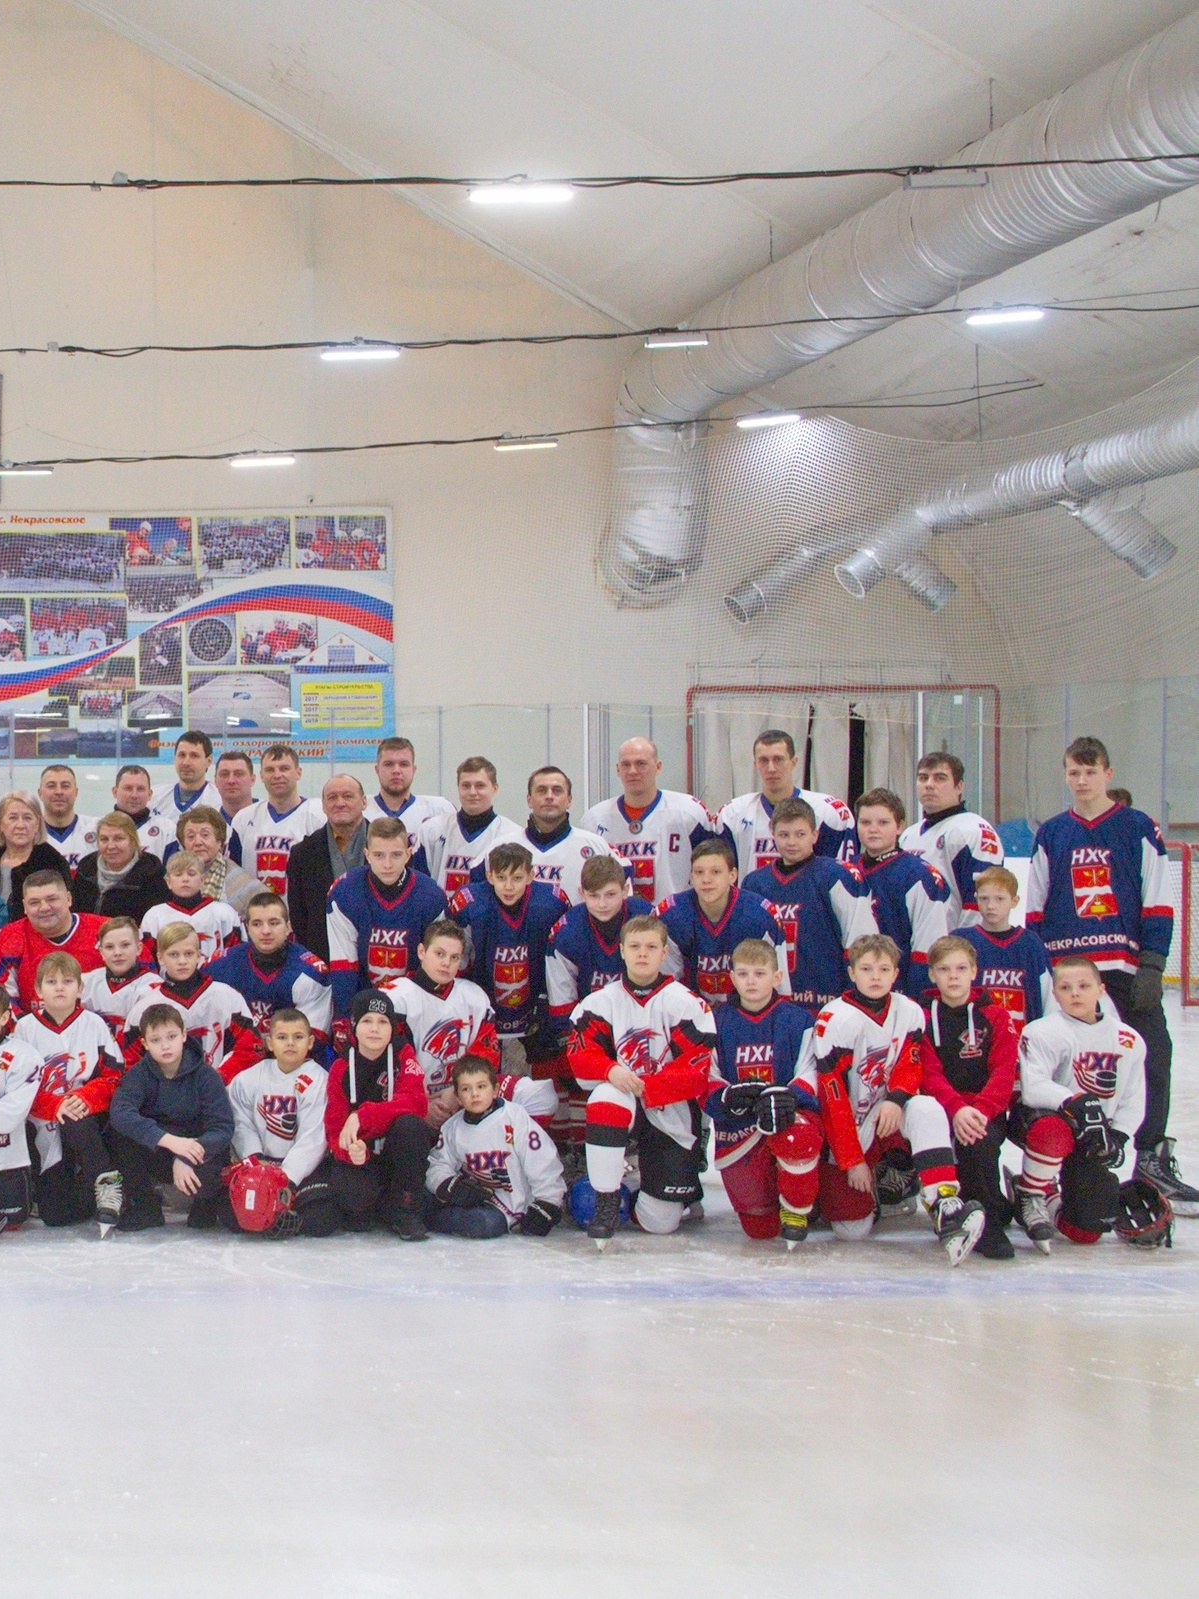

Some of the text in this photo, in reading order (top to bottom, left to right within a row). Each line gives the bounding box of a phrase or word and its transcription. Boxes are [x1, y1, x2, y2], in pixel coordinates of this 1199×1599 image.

[10, 515, 86, 525] Некрасовское
[256, 836, 293, 851] НХК
[1071, 848, 1111, 865] НХК
[534, 866, 564, 880] ХК
[775, 904, 799, 919] ХК
[370, 929, 407, 946] НХК
[982, 969, 1023, 986] НХК
[1078, 1051, 1123, 1072] НХК
[528, 1130, 541, 1150] 8
[663, 1185, 697, 1194] CCM
